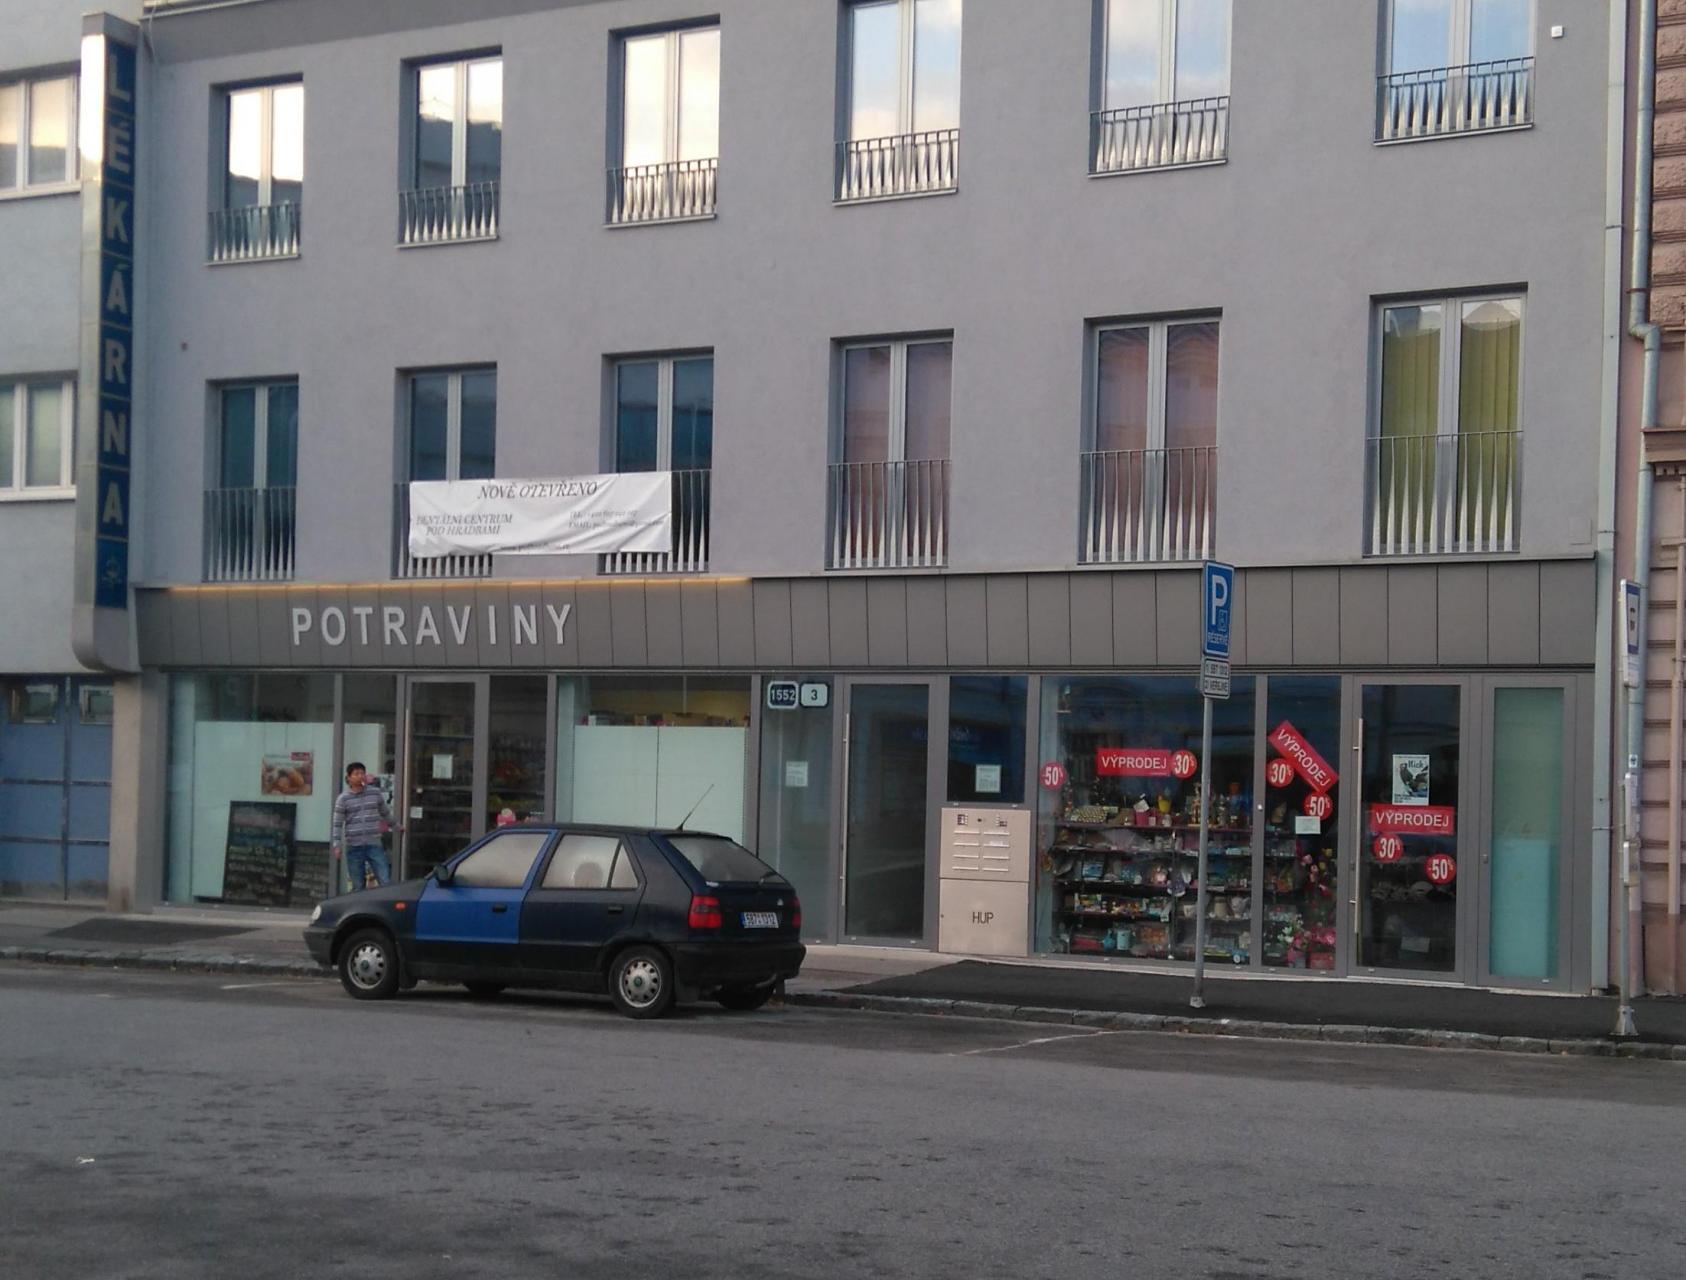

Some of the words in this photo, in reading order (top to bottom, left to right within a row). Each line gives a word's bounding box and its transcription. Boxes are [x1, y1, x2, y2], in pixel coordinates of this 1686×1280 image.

[102, 54, 131, 526] LÉKÁRNA
[478, 482, 516, 499] NOVĚ
[519, 480, 599, 498] OTEVŘENO
[464, 514, 513, 525] CENTRUM
[1211, 574, 1228, 625] P
[292, 604, 571, 646] POTRAVINY
[771, 689, 796, 701] 1552
[810, 689, 818, 701] 3
[1101, 754, 1167, 769] VÝPRODEJ
[1278, 729, 1331, 786] VÝPRODEJ
[1376, 809, 1449, 827] VÝPRODEJ
[972, 911, 994, 924] HUP
